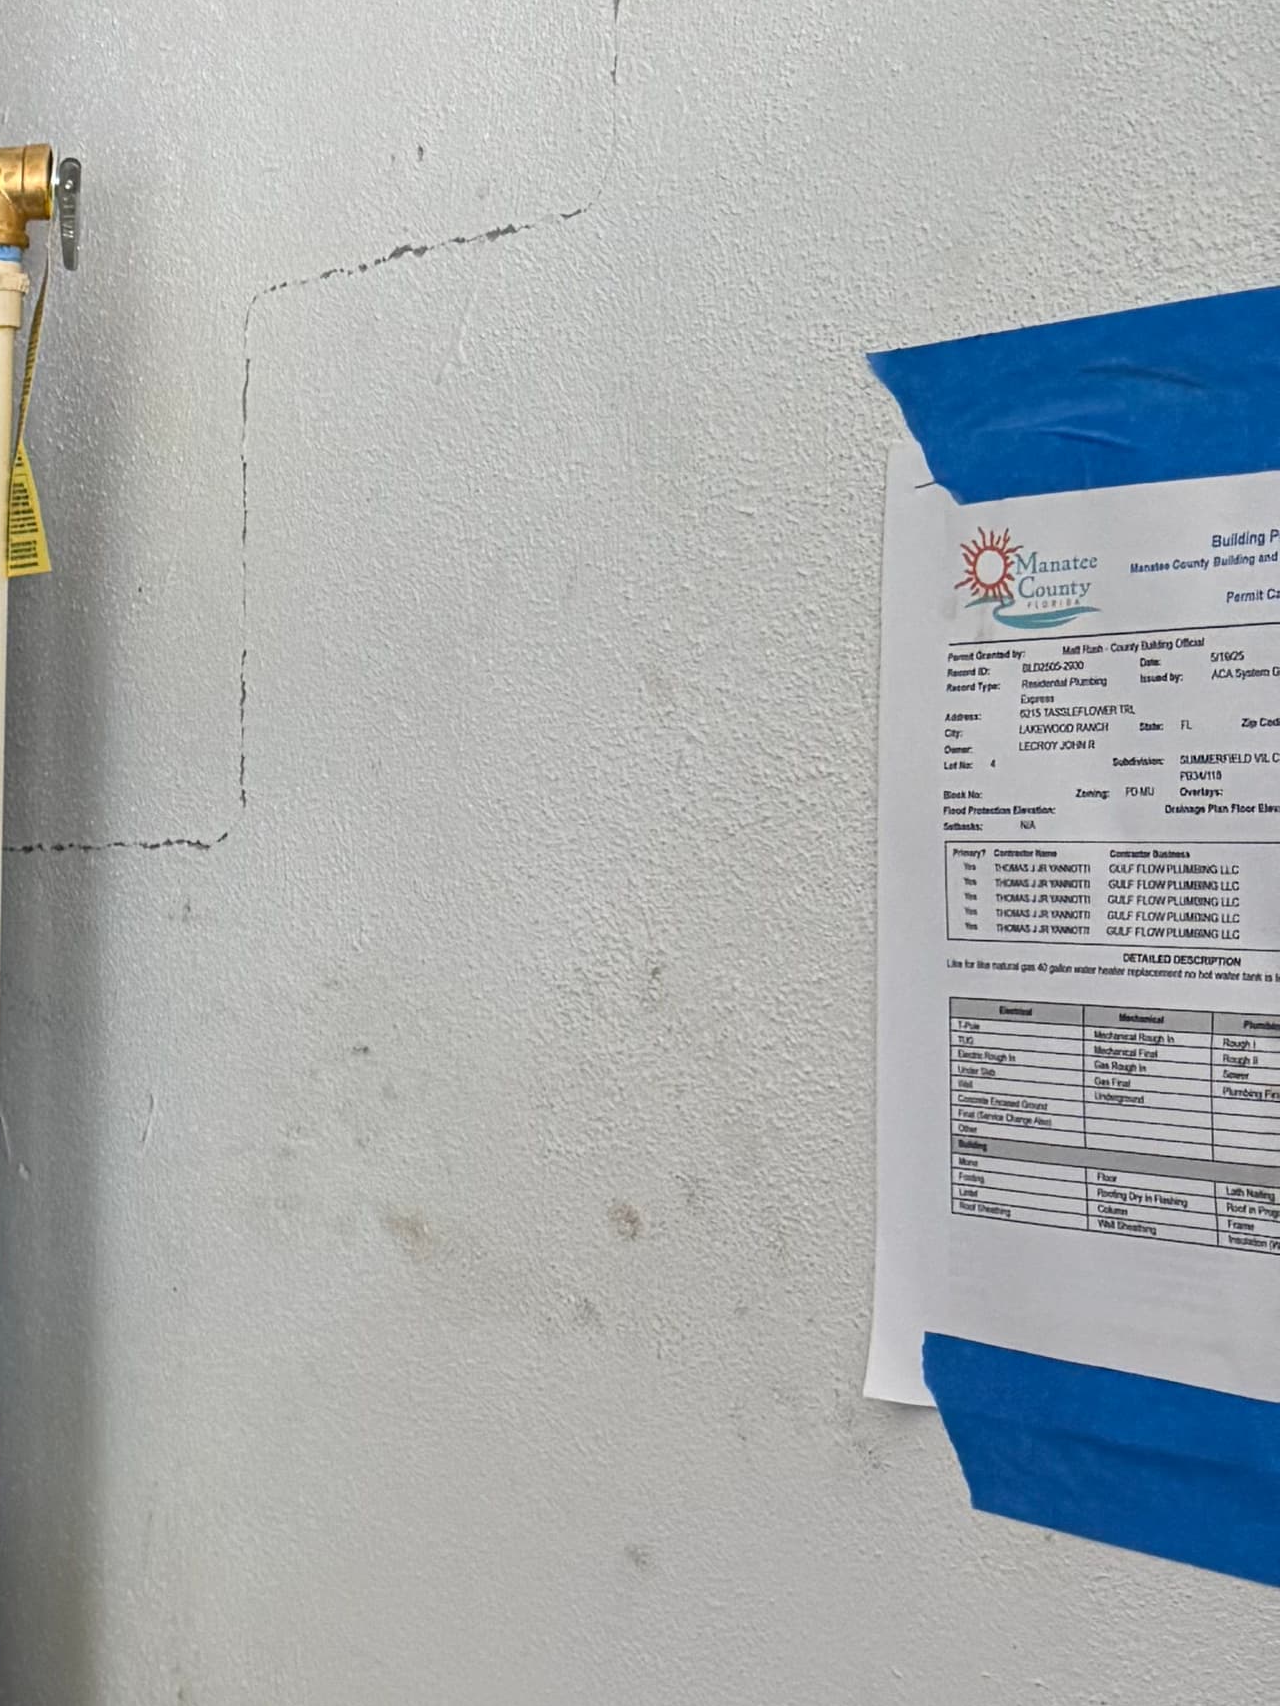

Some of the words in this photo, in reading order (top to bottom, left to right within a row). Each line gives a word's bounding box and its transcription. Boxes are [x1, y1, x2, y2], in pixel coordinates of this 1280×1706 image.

[1212, 532, 1266, 548] Building
[1015, 552, 1097, 575] Manatee
[1130, 562, 1170, 574] Manatee
[1172, 558, 1210, 572] County
[1213, 554, 1256, 568] Building
[1258, 552, 1278, 563] and
[1018, 575, 1091, 599] County
[1227, 590, 1263, 603] Permit
[1211, 668, 1233, 680] ACA
[1076, 722, 1109, 733] RANCH
[1109, 864, 1135, 875] GULF
[1136, 864, 1165, 875] FLOW
[1166, 864, 1217, 875] PLUMBING
[1220, 865, 1240, 876] LLC
[1124, 953, 1171, 964] DETAILED
[1174, 954, 1241, 966] DESCRIPTION
[1215, 971, 1239, 981] water
[1242, 971, 1262, 981] tank
